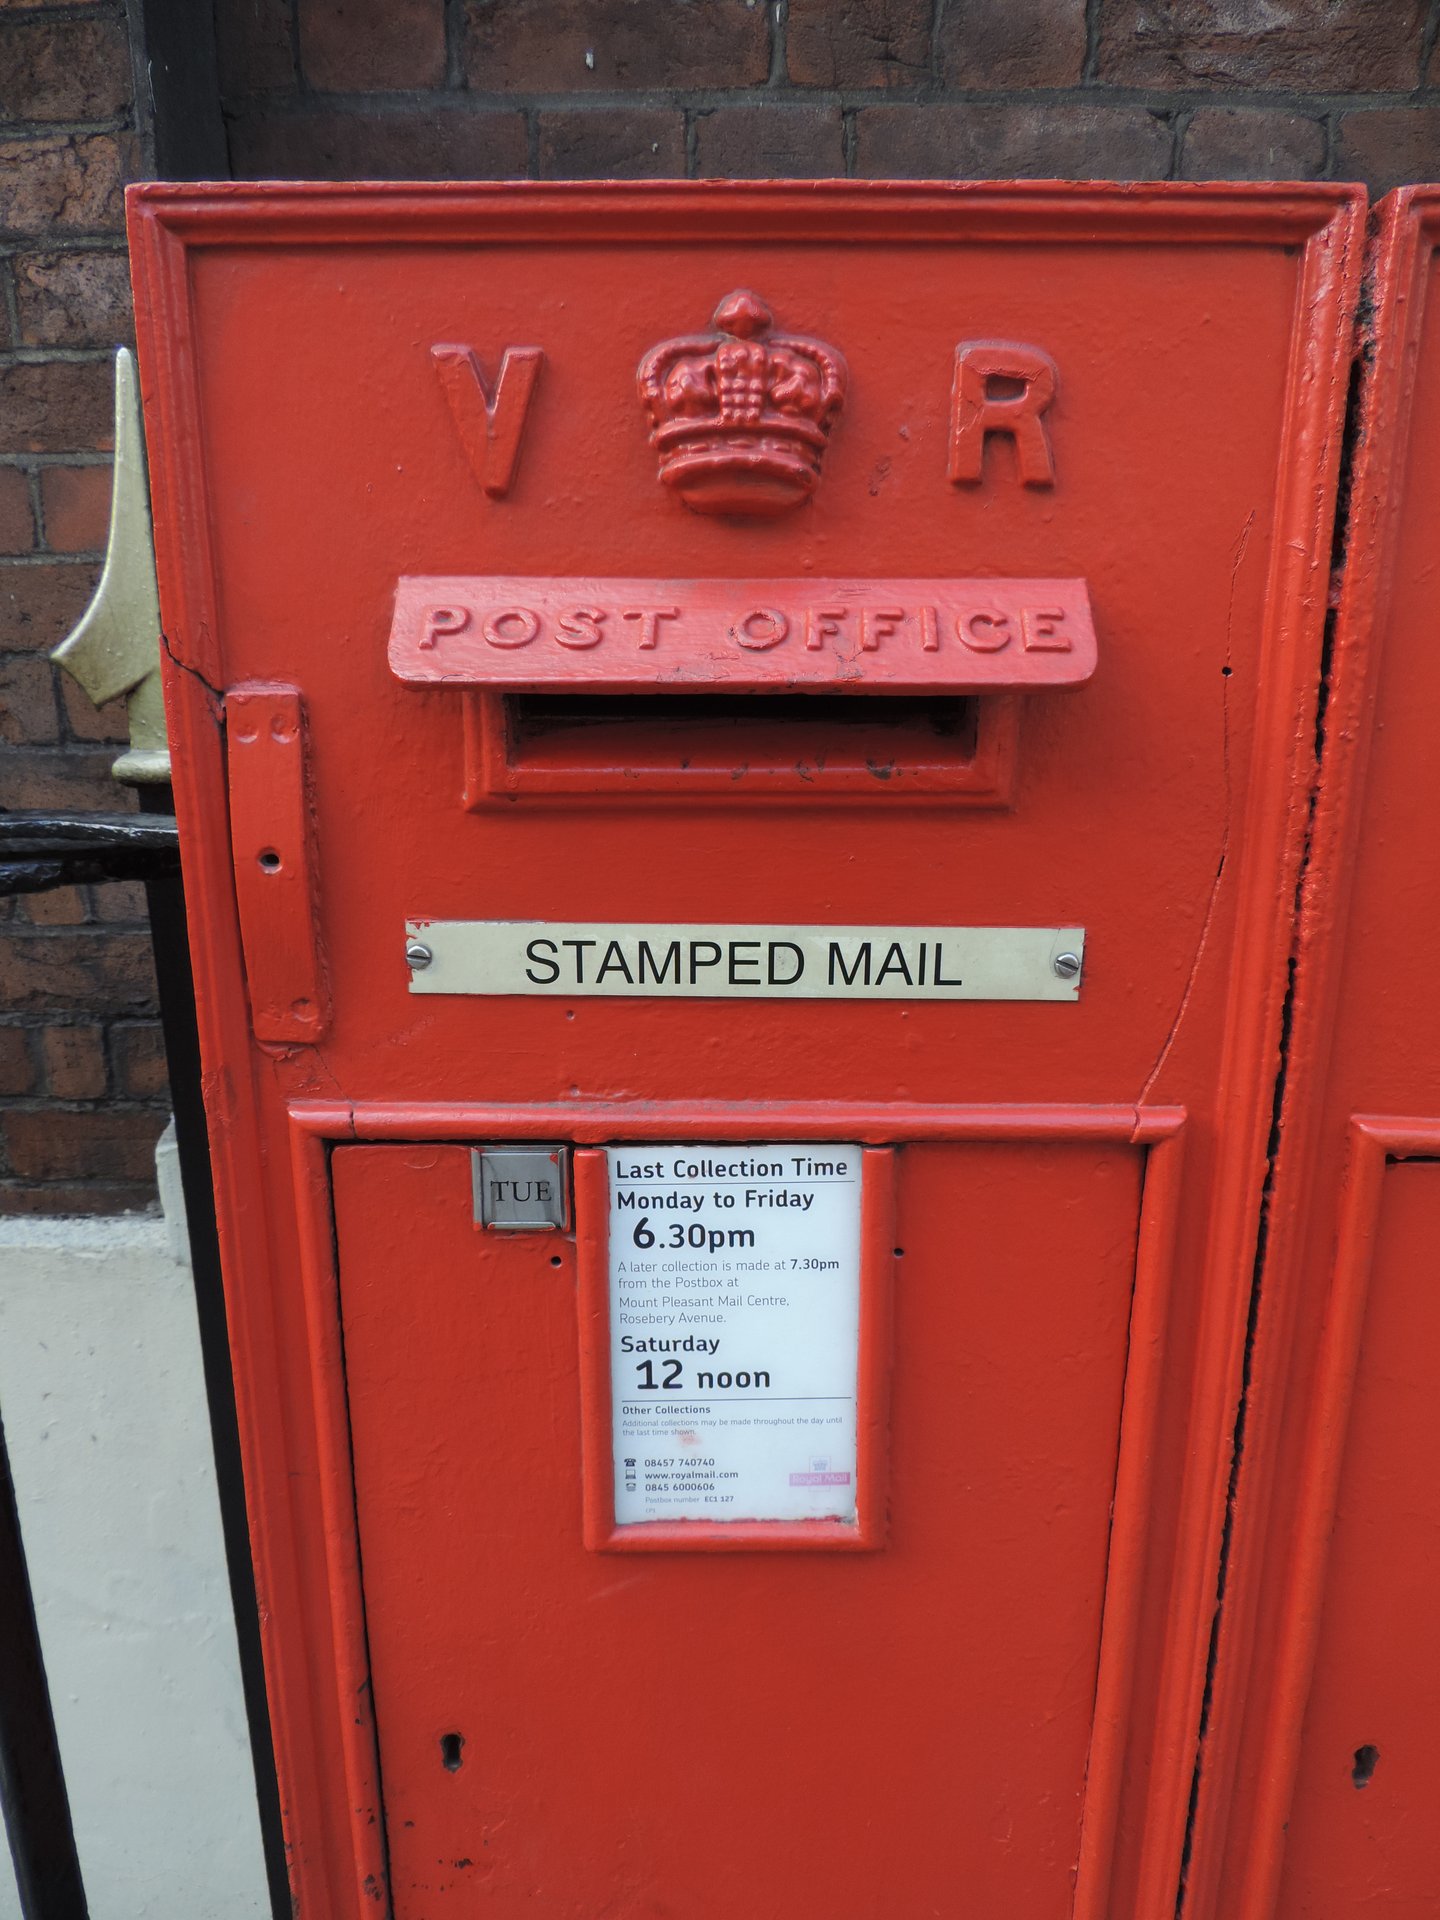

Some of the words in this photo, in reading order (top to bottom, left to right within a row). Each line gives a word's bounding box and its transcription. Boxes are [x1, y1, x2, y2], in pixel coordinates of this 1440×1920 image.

[431, 342, 546, 498] V
[949, 339, 1057, 490] R
[418, 603, 680, 651] POST
[733, 605, 1072, 654] OFFICE
[524, 938, 806, 987] STAMPED
[827, 940, 963, 987] MAIL
[616, 1160, 664, 1179] Last
[673, 1159, 783, 1178] Collection
[791, 1158, 848, 1176] Time
[491, 1181, 551, 1202] TUE
[617, 1192, 705, 1212] Monday
[714, 1192, 735, 1208] to
[745, 1190, 814, 1211] Friday
[633, 1217, 755, 1253] 6.30pm
[618, 1262, 627, 1272] A
[630, 1261, 657, 1272] later
[661, 1261, 718, 1272] collection
[723, 1261, 732, 1271] is
[736, 1260, 770, 1270] made
[774, 1260, 786, 1270] at
[790, 1259, 840, 1272] 7.30pm
[618, 1277, 647, 1289] from
[651, 1277, 671, 1288] the
[675, 1277, 723, 1288] Postbox
[727, 1277, 739, 1288] at
[619, 1297, 658, 1308] Mount
[662, 1296, 714, 1308] Pleasant
[718, 1295, 743, 1307] Mail
[620, 1313, 675, 1326] Rosebery
[678, 1312, 726, 1324] Avenue.
[621, 1335, 720, 1355] Saturday
[636, 1359, 683, 1390] 12
[697, 1370, 770, 1389] noon
[623, 1406, 651, 1415] Other
[655, 1405, 711, 1415] Collections
[753, 1417, 795, 1426] throughout
[811, 1417, 824, 1425] day
[645, 1459, 674, 1467] 08457
[645, 1471, 739, 1480] www.royalmail.com
[793, 1475, 822, 1485] Royal
[825, 1474, 847, 1482] Mail
[673, 1483, 715, 1491] 6000606
